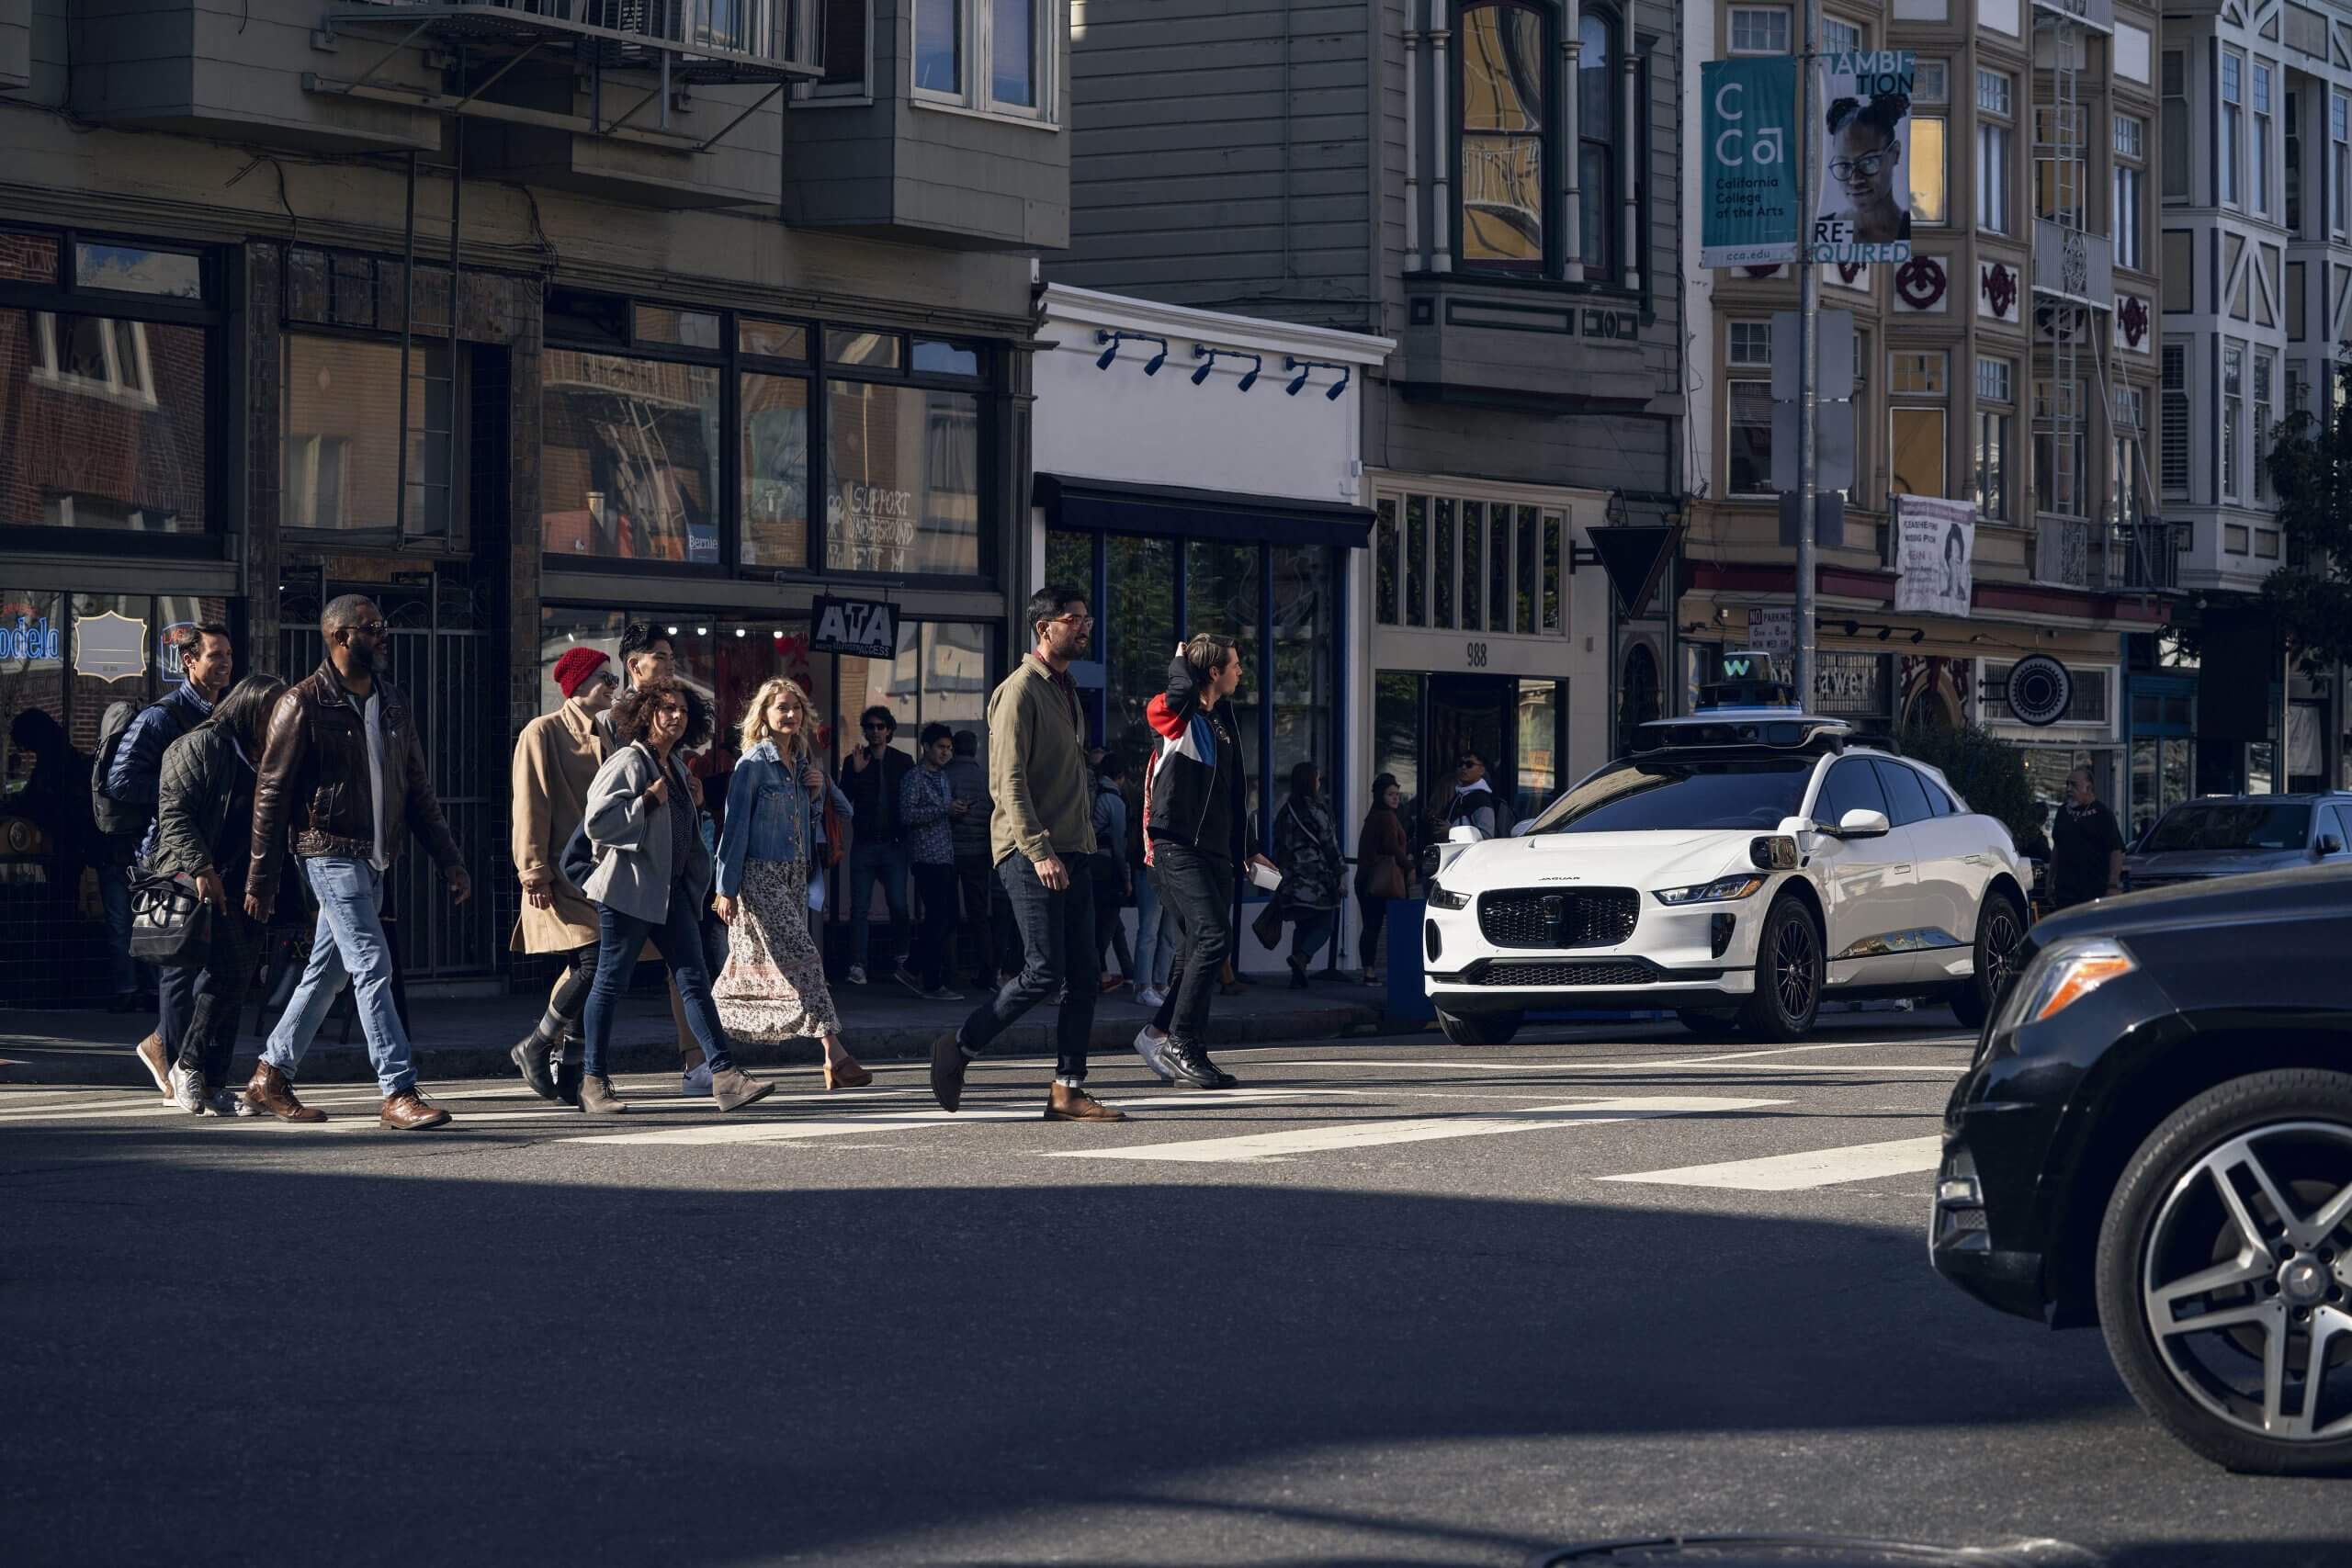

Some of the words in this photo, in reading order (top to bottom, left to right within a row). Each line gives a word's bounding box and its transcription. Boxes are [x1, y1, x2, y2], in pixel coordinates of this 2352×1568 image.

[1836, 51, 1915, 73] AMBI-
[1856, 74, 1914, 95] TION
[1715, 176, 1780, 189] California
[1715, 193, 1762, 206] College
[1715, 208, 1729, 219] of
[1733, 207, 1754, 218] the
[1756, 205, 1784, 217] Arts
[1814, 222, 1853, 243] RE-
[1726, 249, 1770, 261] cca.edu
[1814, 243, 1911, 264] QUIRED
[852, 487, 911, 515] SUPPORT
[689, 536, 718, 550] Bernie
[816, 602, 893, 647] ATA
[1749, 610, 1762, 625] NO
[858, 644, 891, 657] ACCESS
[1467, 642, 1487, 668] 988
